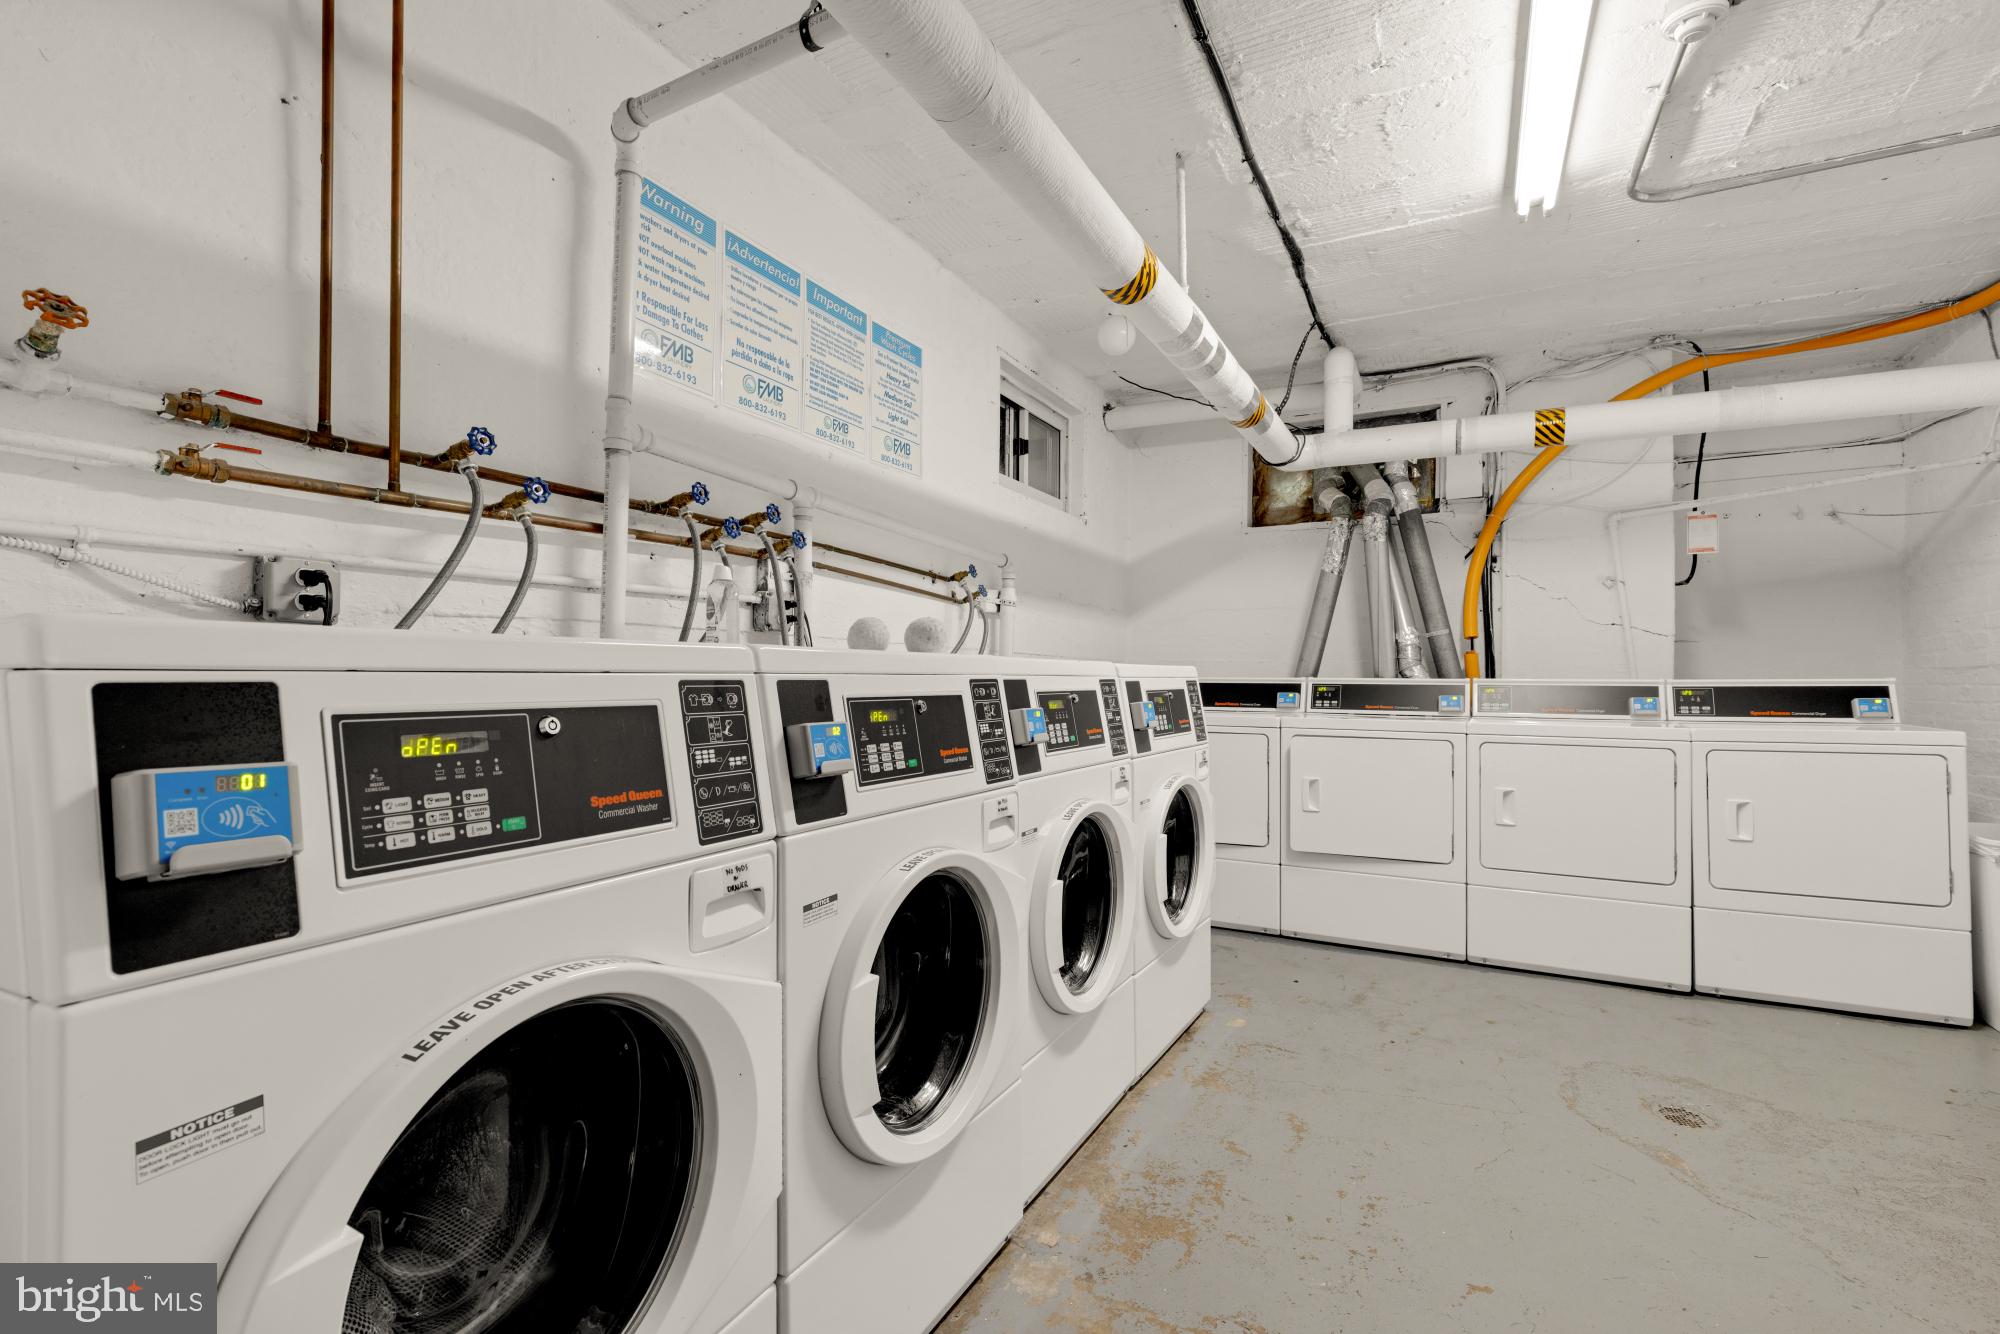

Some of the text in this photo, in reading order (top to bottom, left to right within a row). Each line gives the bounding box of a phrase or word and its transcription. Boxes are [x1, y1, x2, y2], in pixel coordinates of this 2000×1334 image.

[640, 182, 704, 234] Warning
[642, 292, 681, 319] Responsible
[683, 312, 693, 324] For
[695, 317, 709, 332] Loss
[813, 288, 863, 325] Important
[642, 305, 669, 326] Damage
[672, 319, 679, 330] To
[681, 323, 704, 341] Clothes
[660, 334, 694, 364] FMB
[736, 337, 744, 348] No
[757, 378, 784, 403] FMB
[832, 419, 849, 434] FMB
[893, 438, 911, 456] FMB
[590, 788, 663, 808] Speed Queen
[598, 803, 658, 819] Commercial Washer
[401, 959, 592, 1063] LEAVE OPEN AFTER
[170, 1106, 235, 1140] NOTICE
